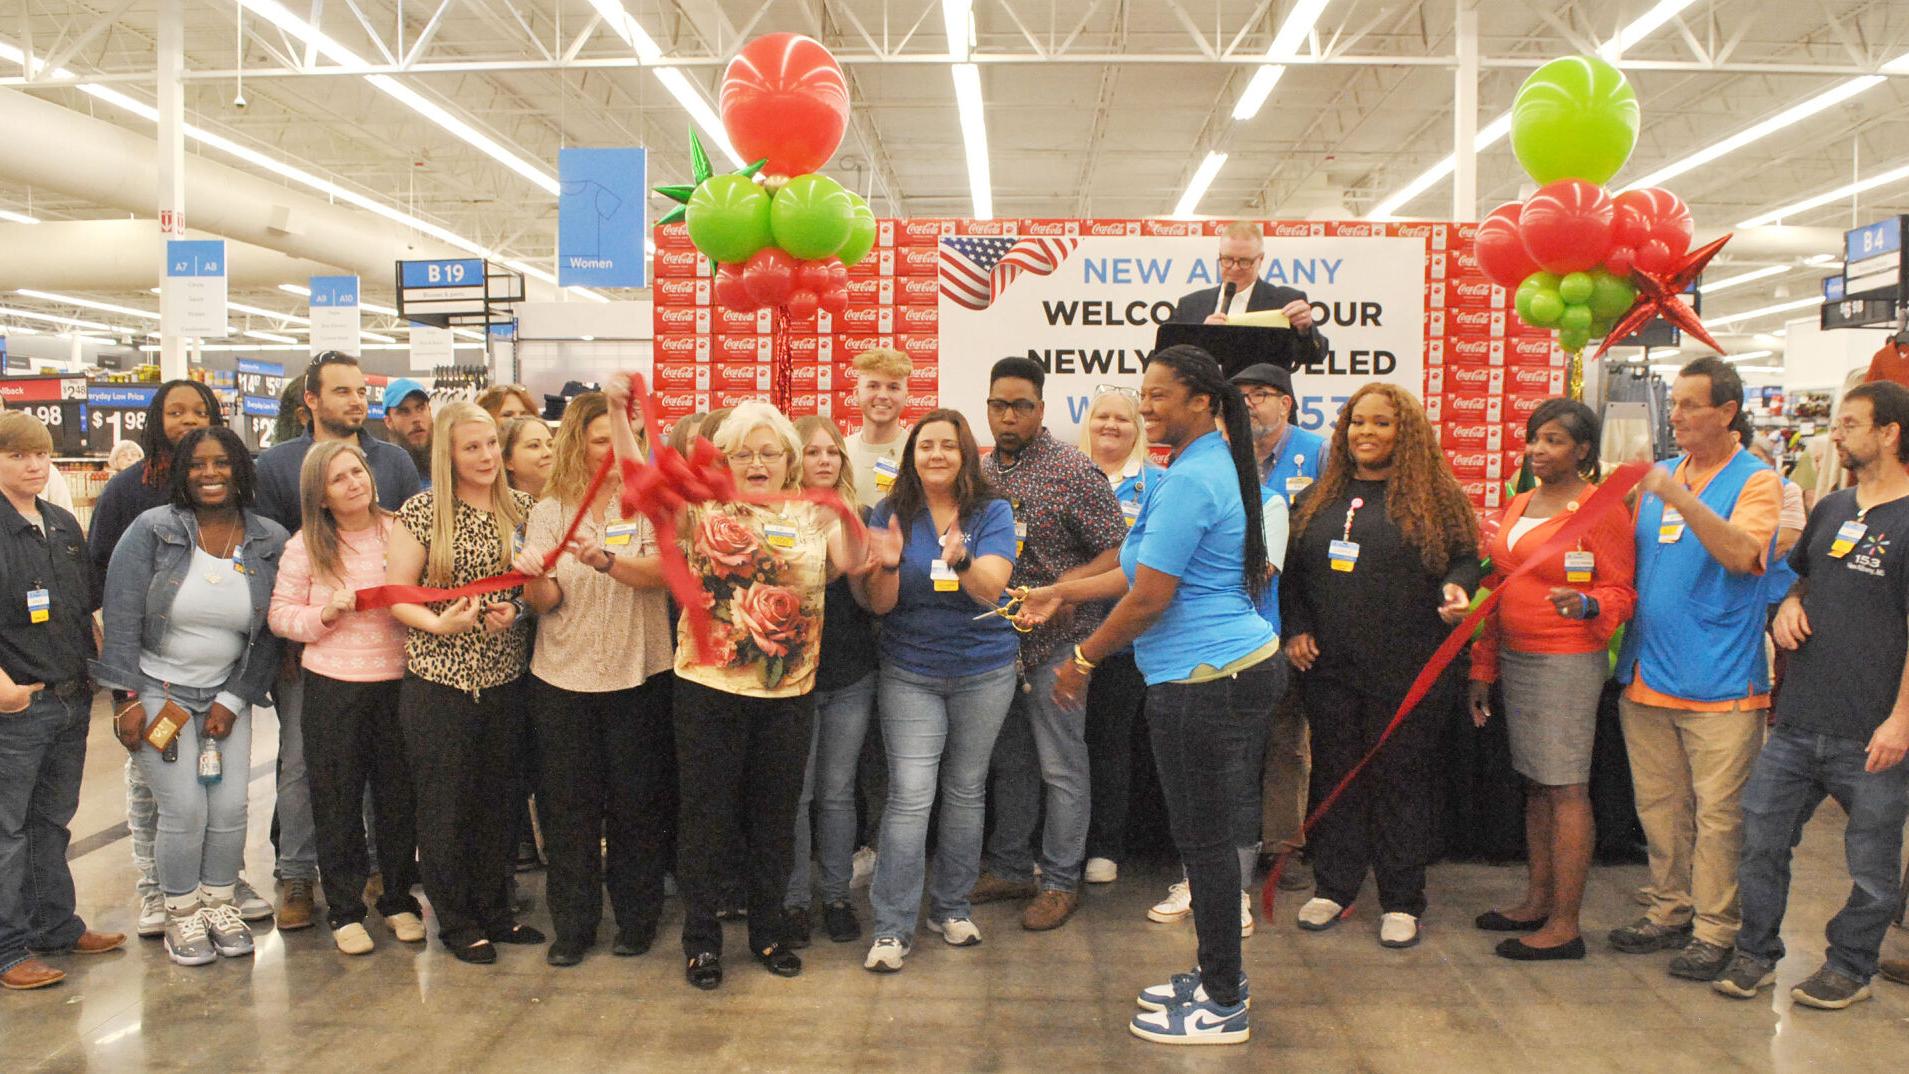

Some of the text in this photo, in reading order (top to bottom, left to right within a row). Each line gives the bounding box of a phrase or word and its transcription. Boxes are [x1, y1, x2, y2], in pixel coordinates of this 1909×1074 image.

[175, 262, 188, 272] A7
[570, 257, 613, 270] Women
[1084, 258, 1343, 285] NEW AANY
[1042, 300, 1176, 326] WELCO
[0, 386, 24, 395] ollback
[88, 394, 110, 402] eryday
[1855, 554, 1881, 568] 153
